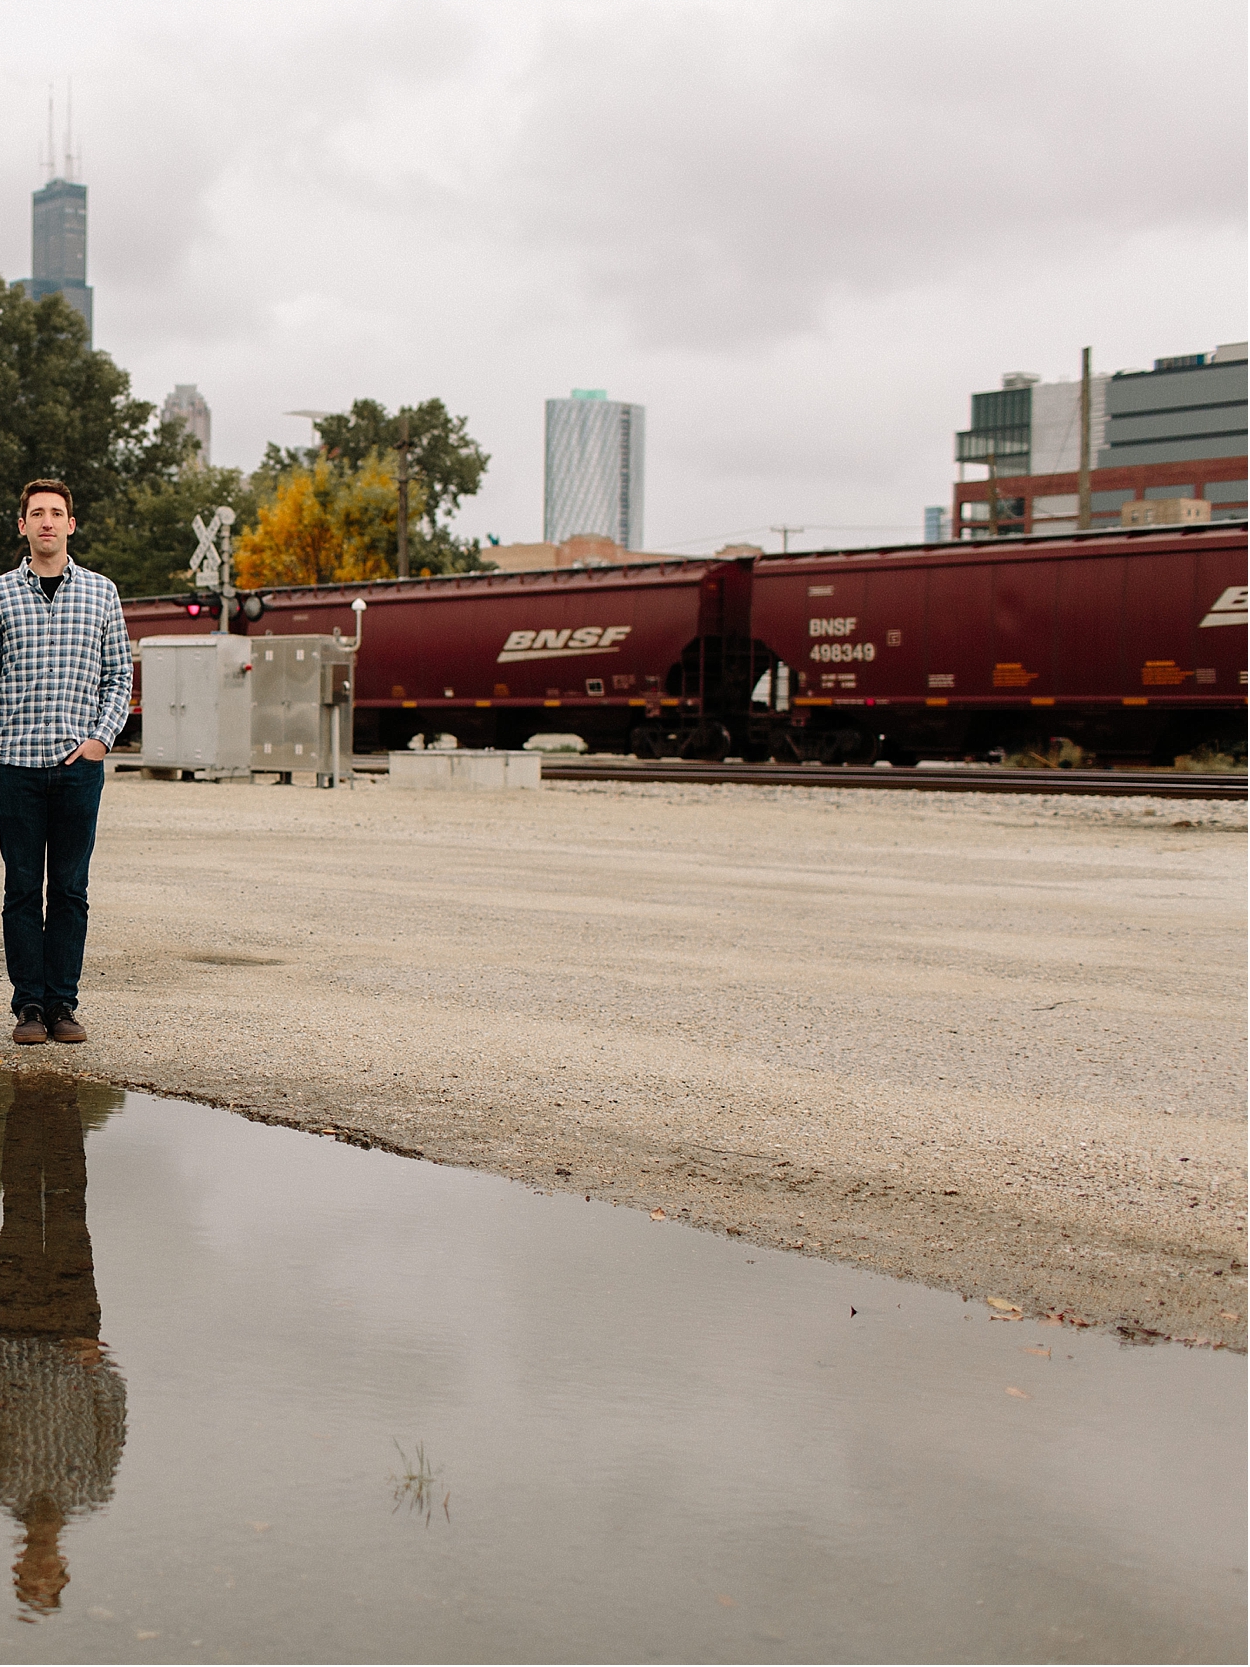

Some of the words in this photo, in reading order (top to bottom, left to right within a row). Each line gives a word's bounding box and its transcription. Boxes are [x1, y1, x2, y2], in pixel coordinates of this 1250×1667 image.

[809, 617, 857, 637] BNSF
[503, 625, 632, 651] BNSF
[810, 642, 876, 663] 498349
